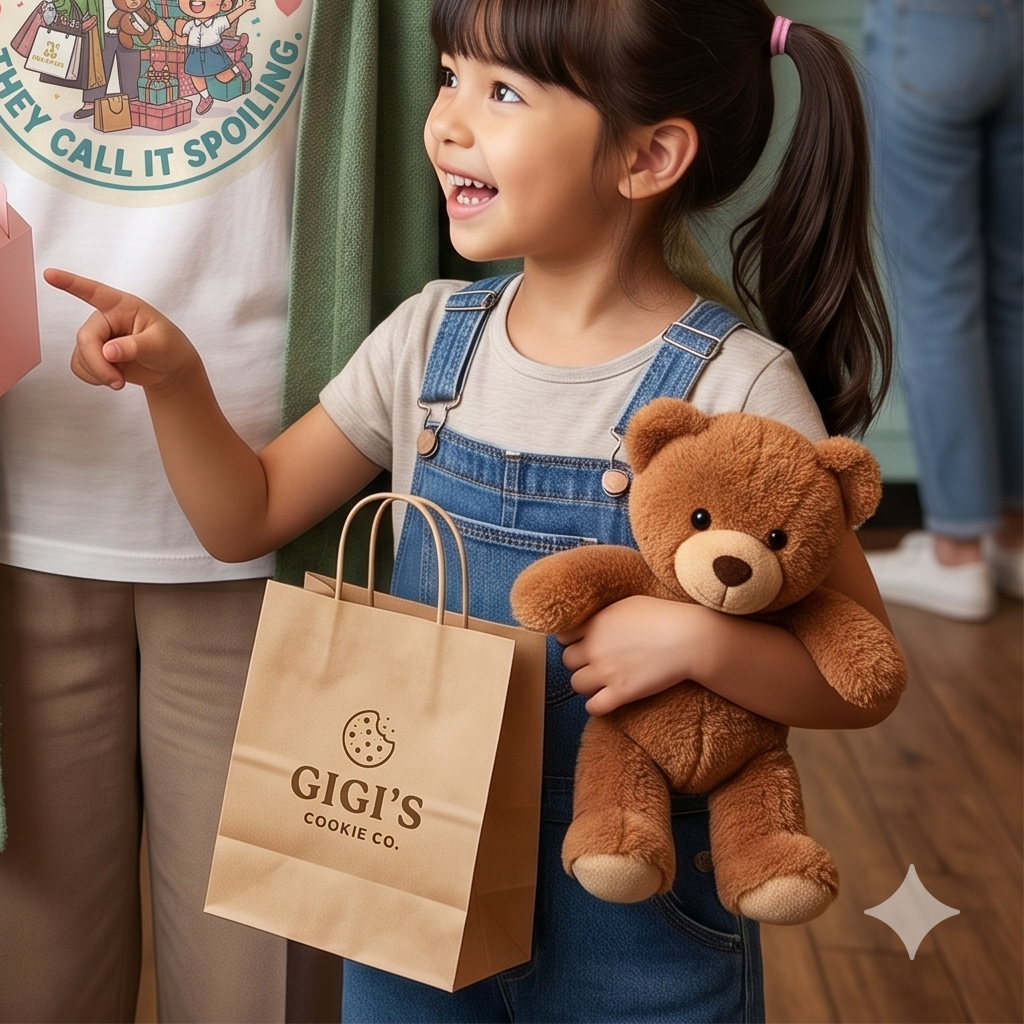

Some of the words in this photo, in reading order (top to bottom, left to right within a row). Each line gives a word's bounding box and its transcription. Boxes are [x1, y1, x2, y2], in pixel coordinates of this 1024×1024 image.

[49, 127, 133, 178] CALL
[144, 147, 175, 178] IT
[183, 32, 303, 168] SPOILING.
[291, 765, 424, 830] GIGI’S
[303, 812, 368, 841] COOKIE
[371, 832, 399, 851] CO.
